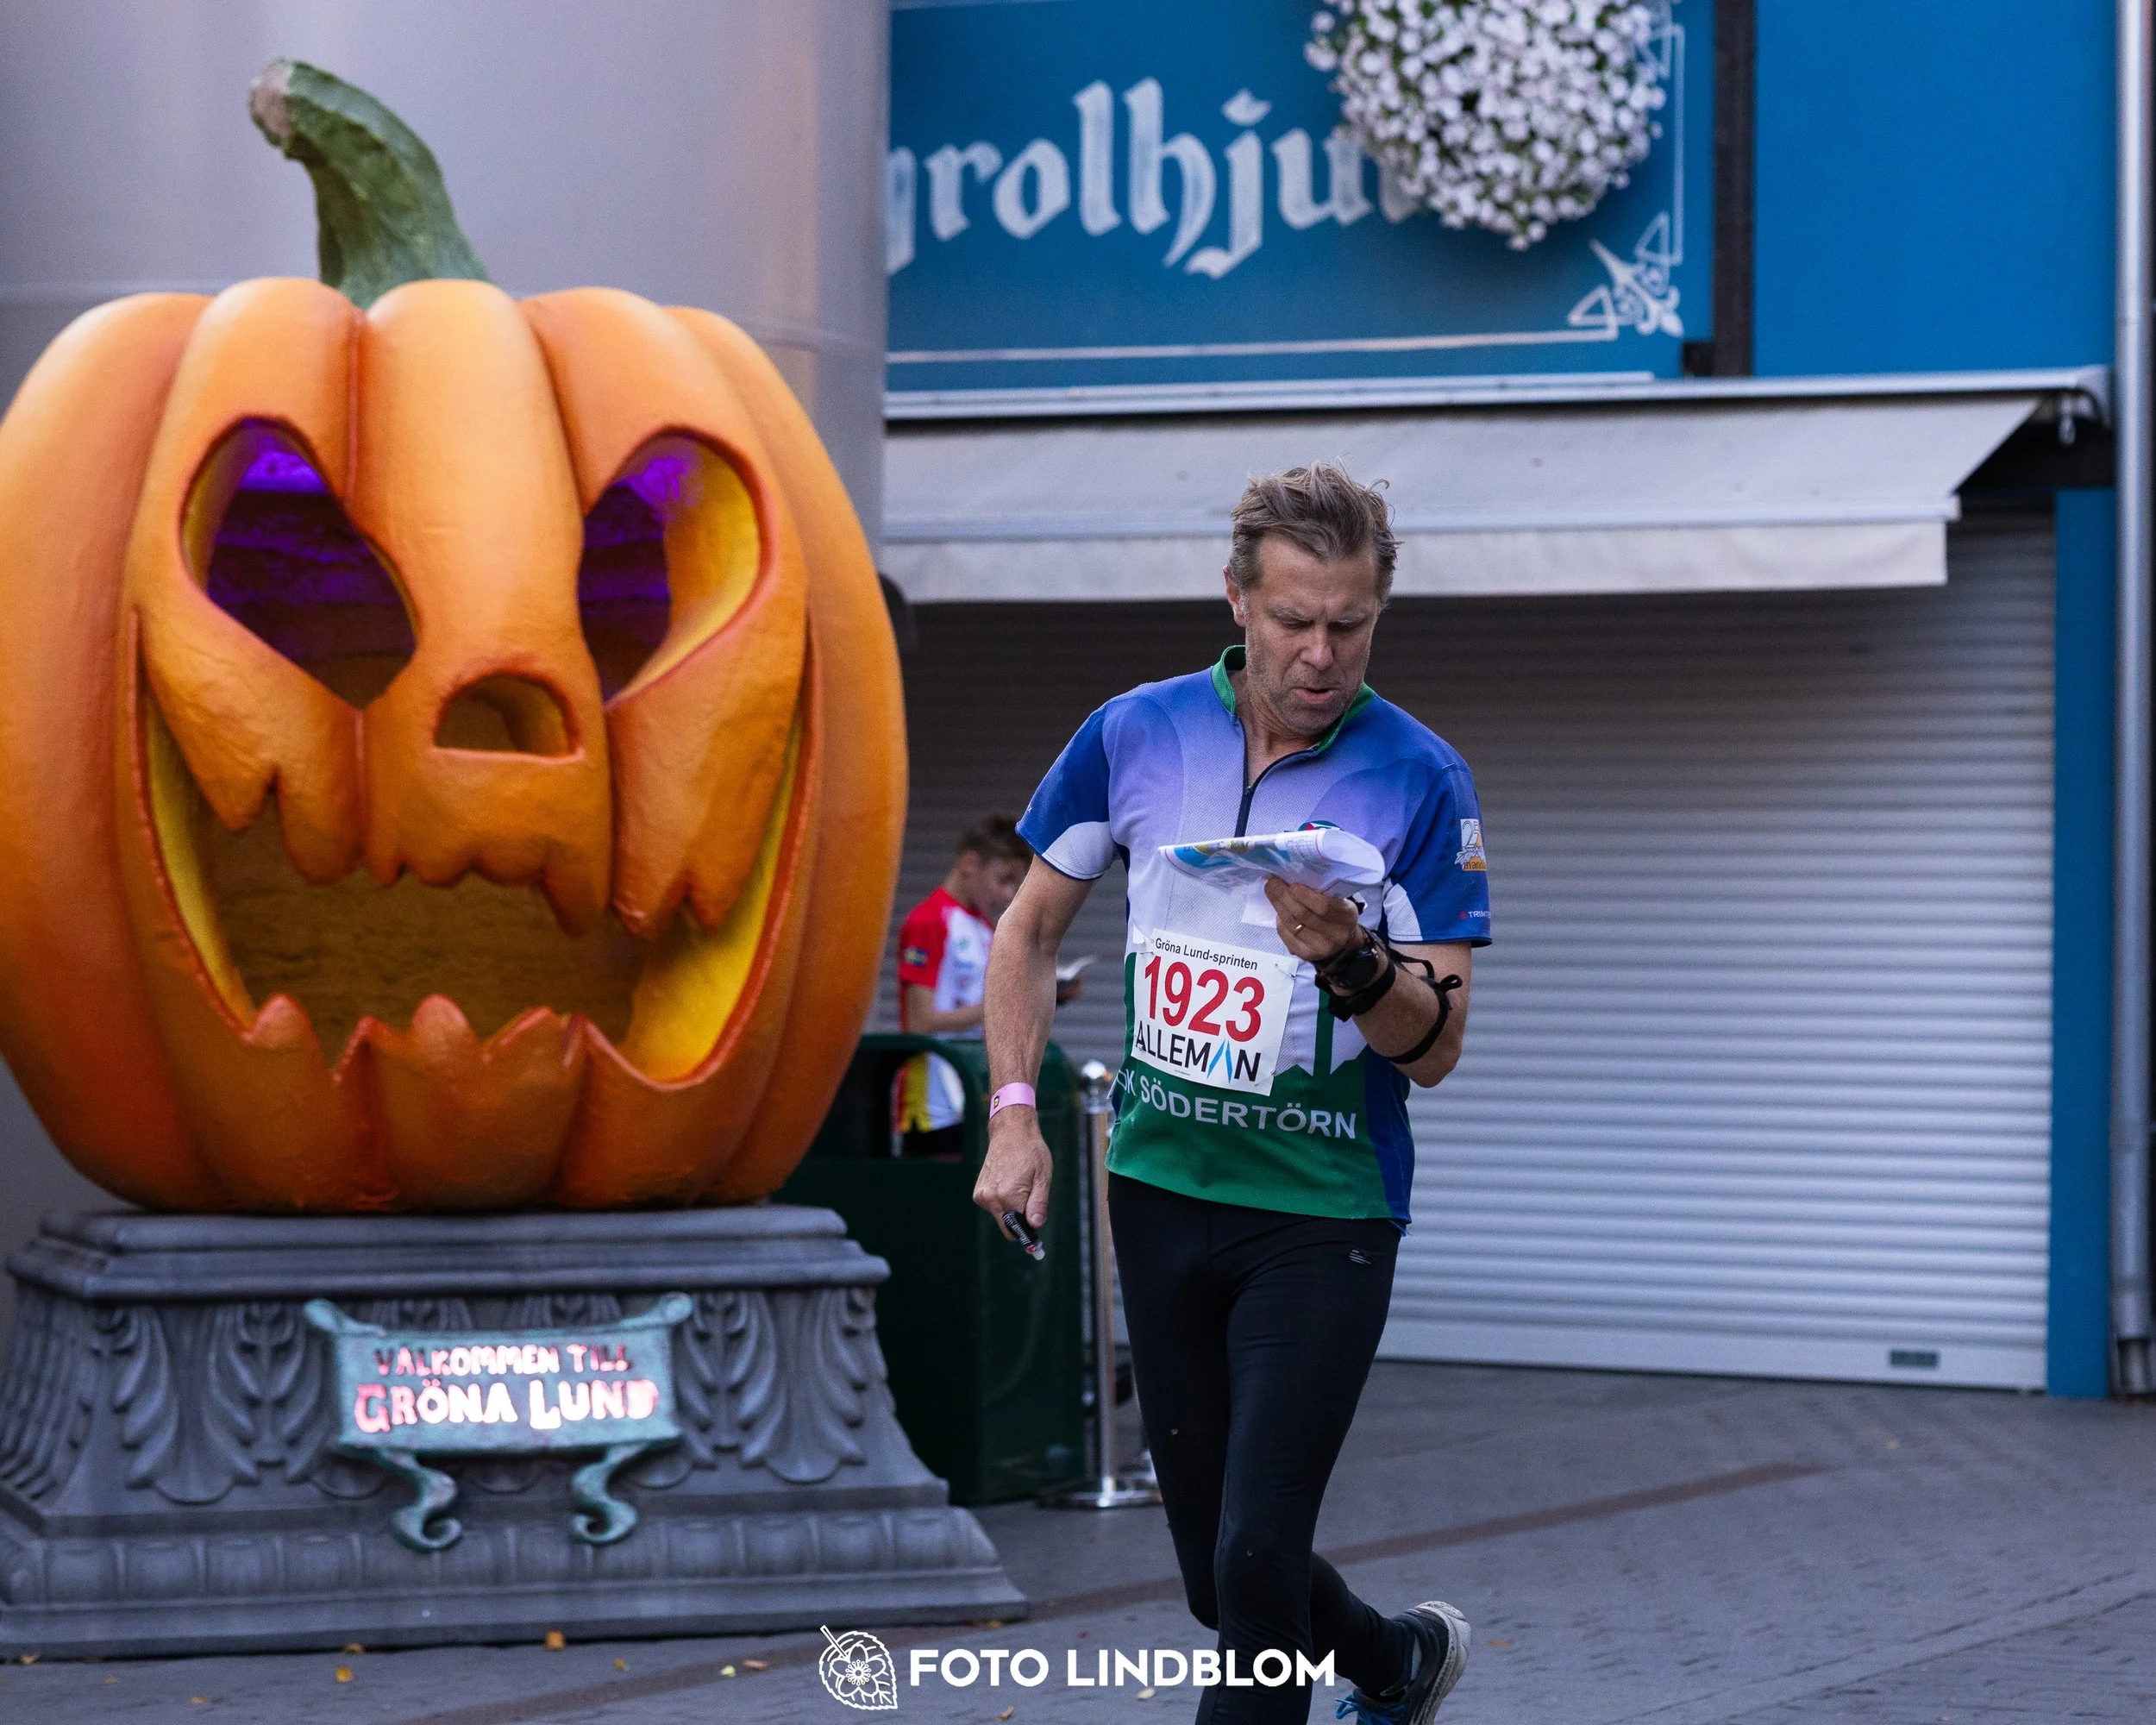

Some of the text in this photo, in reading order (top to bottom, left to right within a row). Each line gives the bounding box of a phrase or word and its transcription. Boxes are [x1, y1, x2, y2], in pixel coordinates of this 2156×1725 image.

[1156, 938, 1258, 971] Gröna Lund-sprinten
[1144, 955, 1265, 1043] 1923
[1135, 1020, 1262, 1084] ALLEMAN
[1139, 1075, 1357, 1139] SÖDERTÖRN
[566, 1343, 630, 1373] TILL
[354, 1378, 660, 1433] GRÖNA LUND
